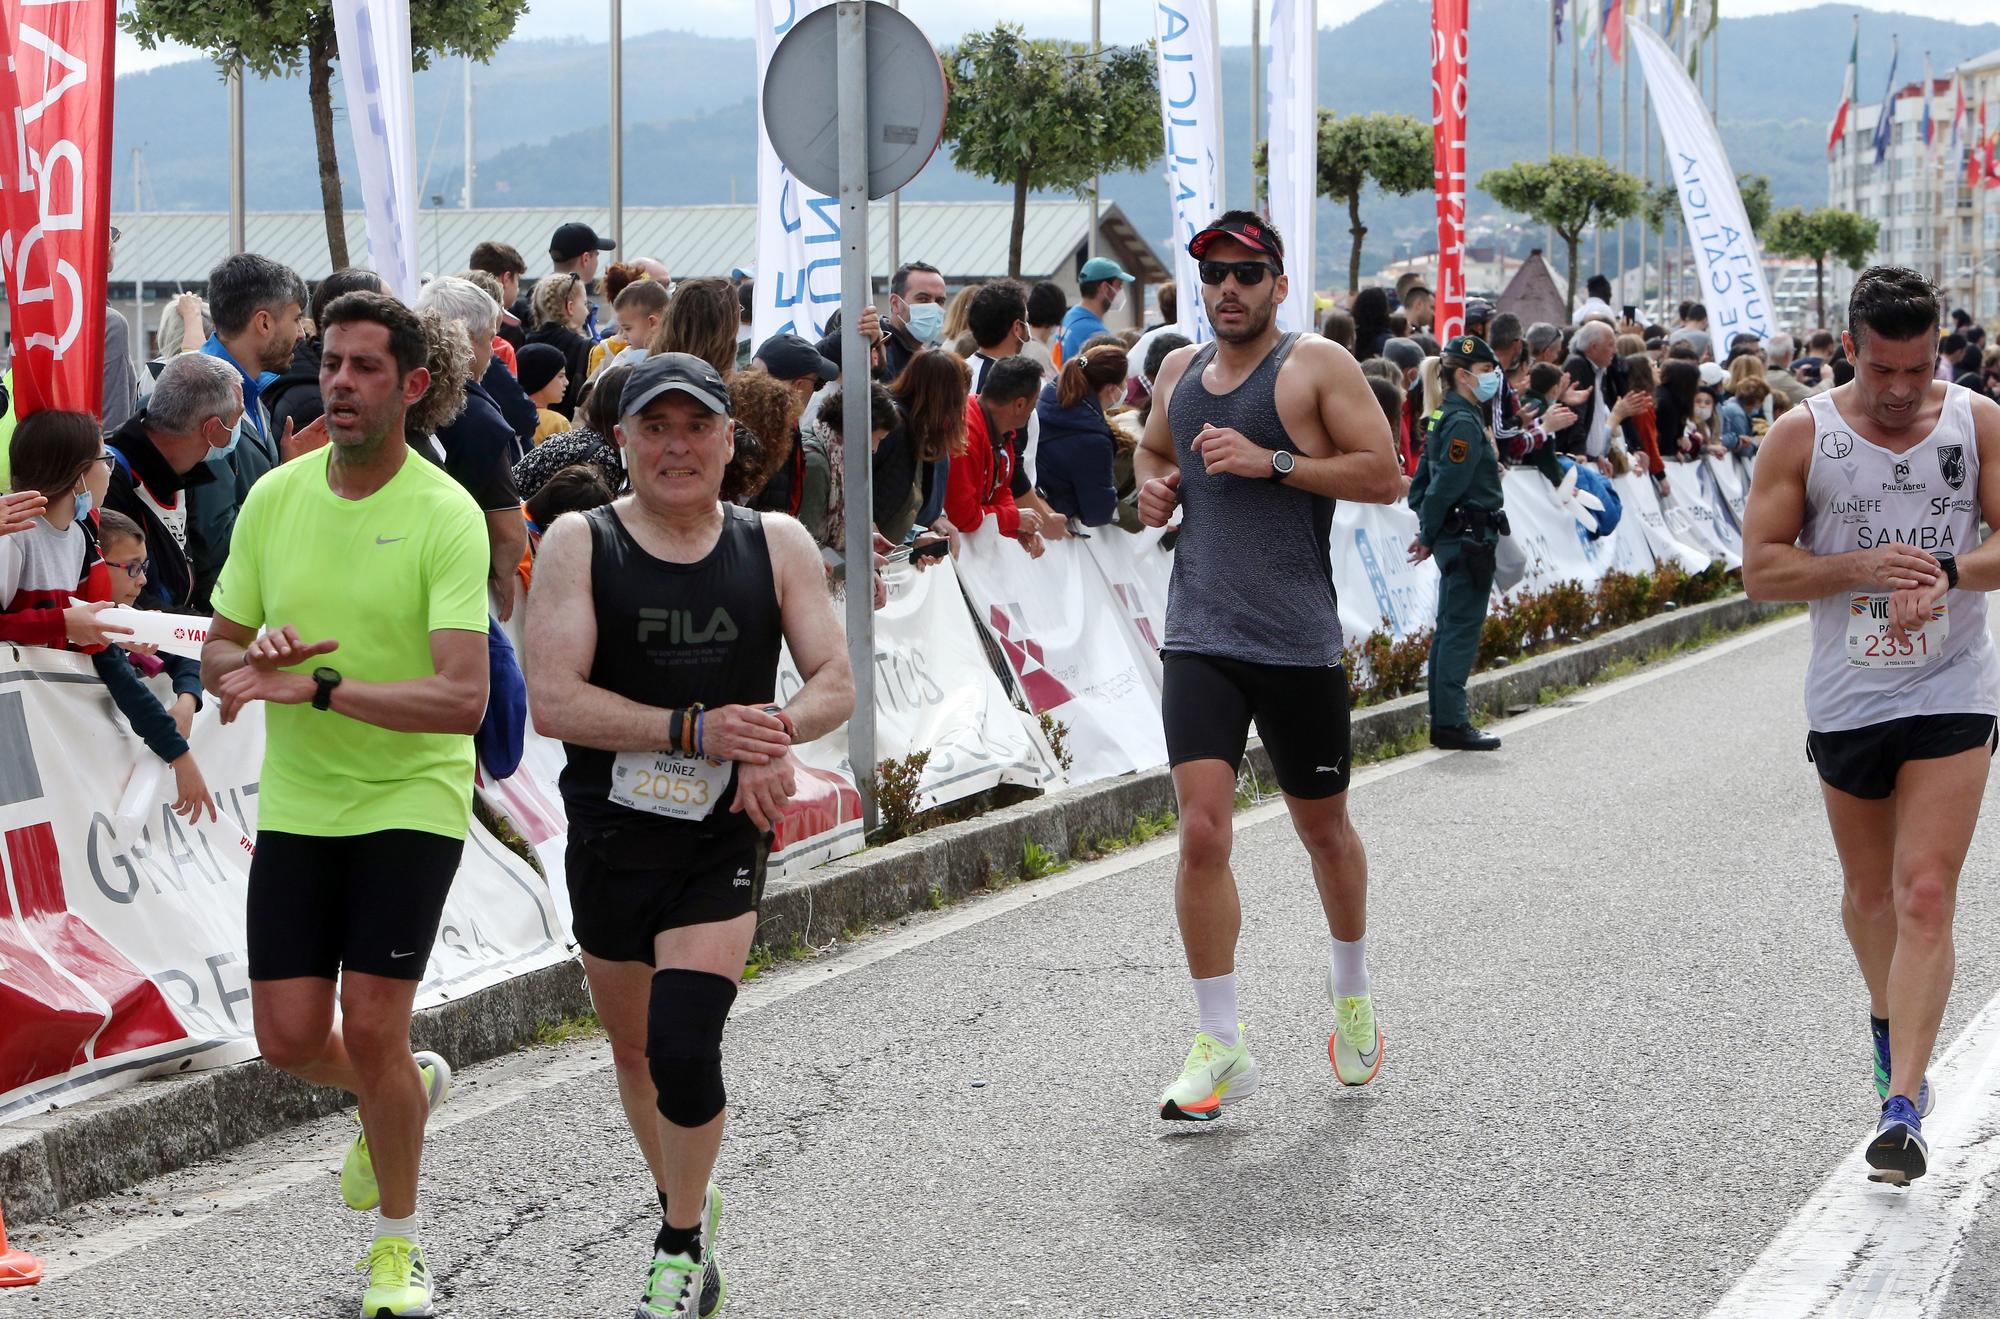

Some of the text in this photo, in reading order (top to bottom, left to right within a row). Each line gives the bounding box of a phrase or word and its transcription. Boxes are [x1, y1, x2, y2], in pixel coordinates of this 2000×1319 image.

[1903, 482, 1926, 491] Abreu
[1831, 499, 1882, 514] LUNEFE
[1857, 525, 1955, 550] SAMBA
[637, 606, 739, 645] FILA
[1864, 632, 1927, 657] 2351
[654, 761, 696, 777] NUÑEZ
[632, 769, 710, 806] 2053
